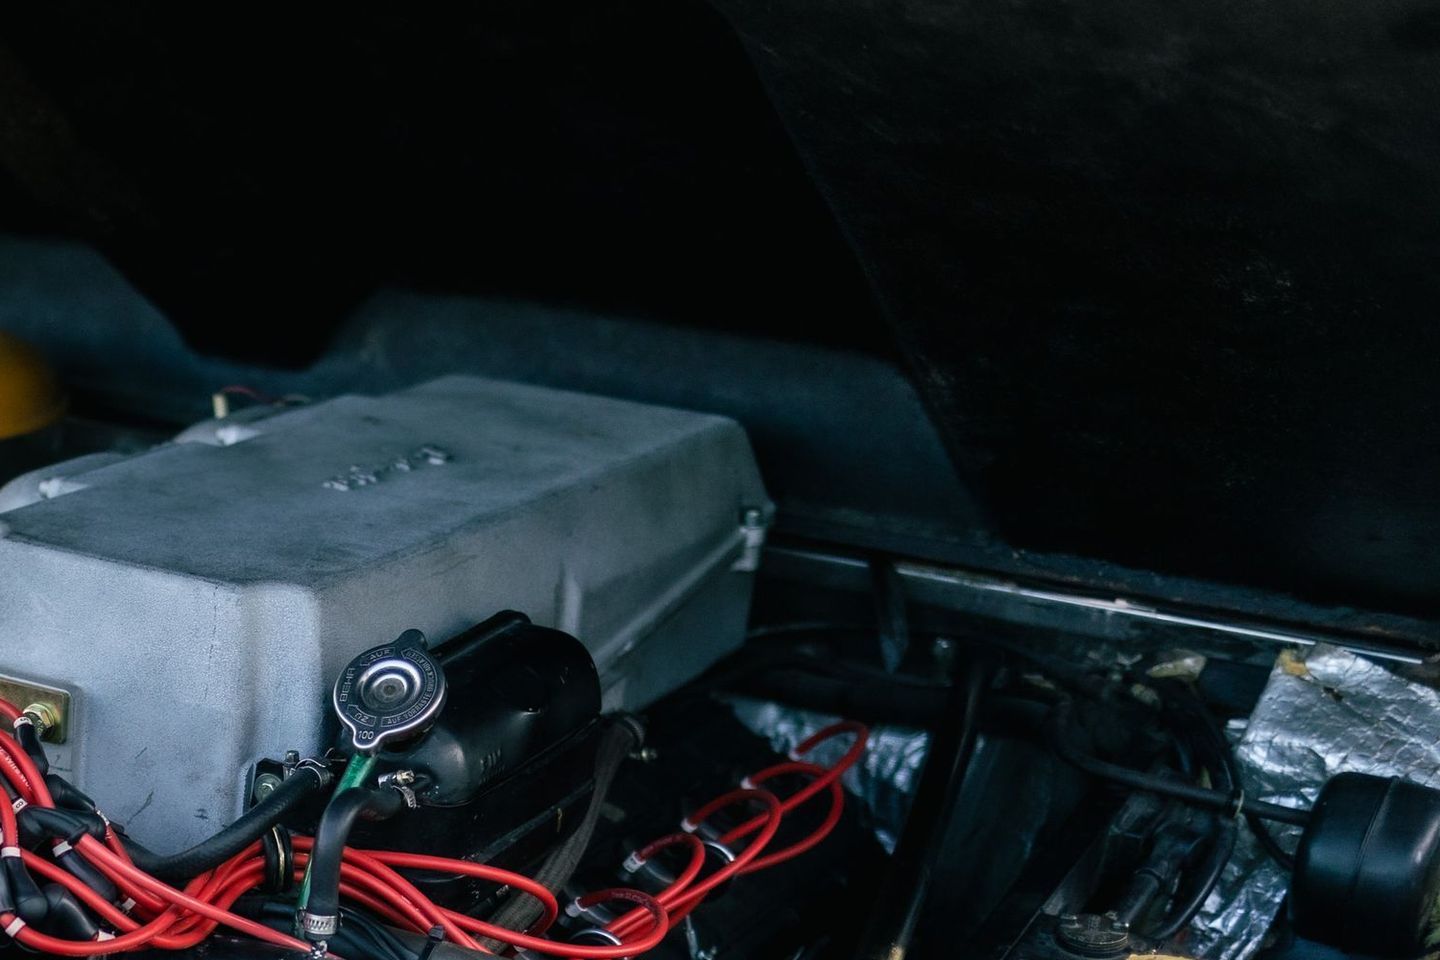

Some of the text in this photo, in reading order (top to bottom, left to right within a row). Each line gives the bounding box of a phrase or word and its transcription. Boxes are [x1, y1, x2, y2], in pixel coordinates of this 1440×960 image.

[369, 649, 391, 661] AUF
[339, 667, 356, 702] BEHR
[354, 712, 369, 723] ZU
[358, 730, 374, 740] 100
